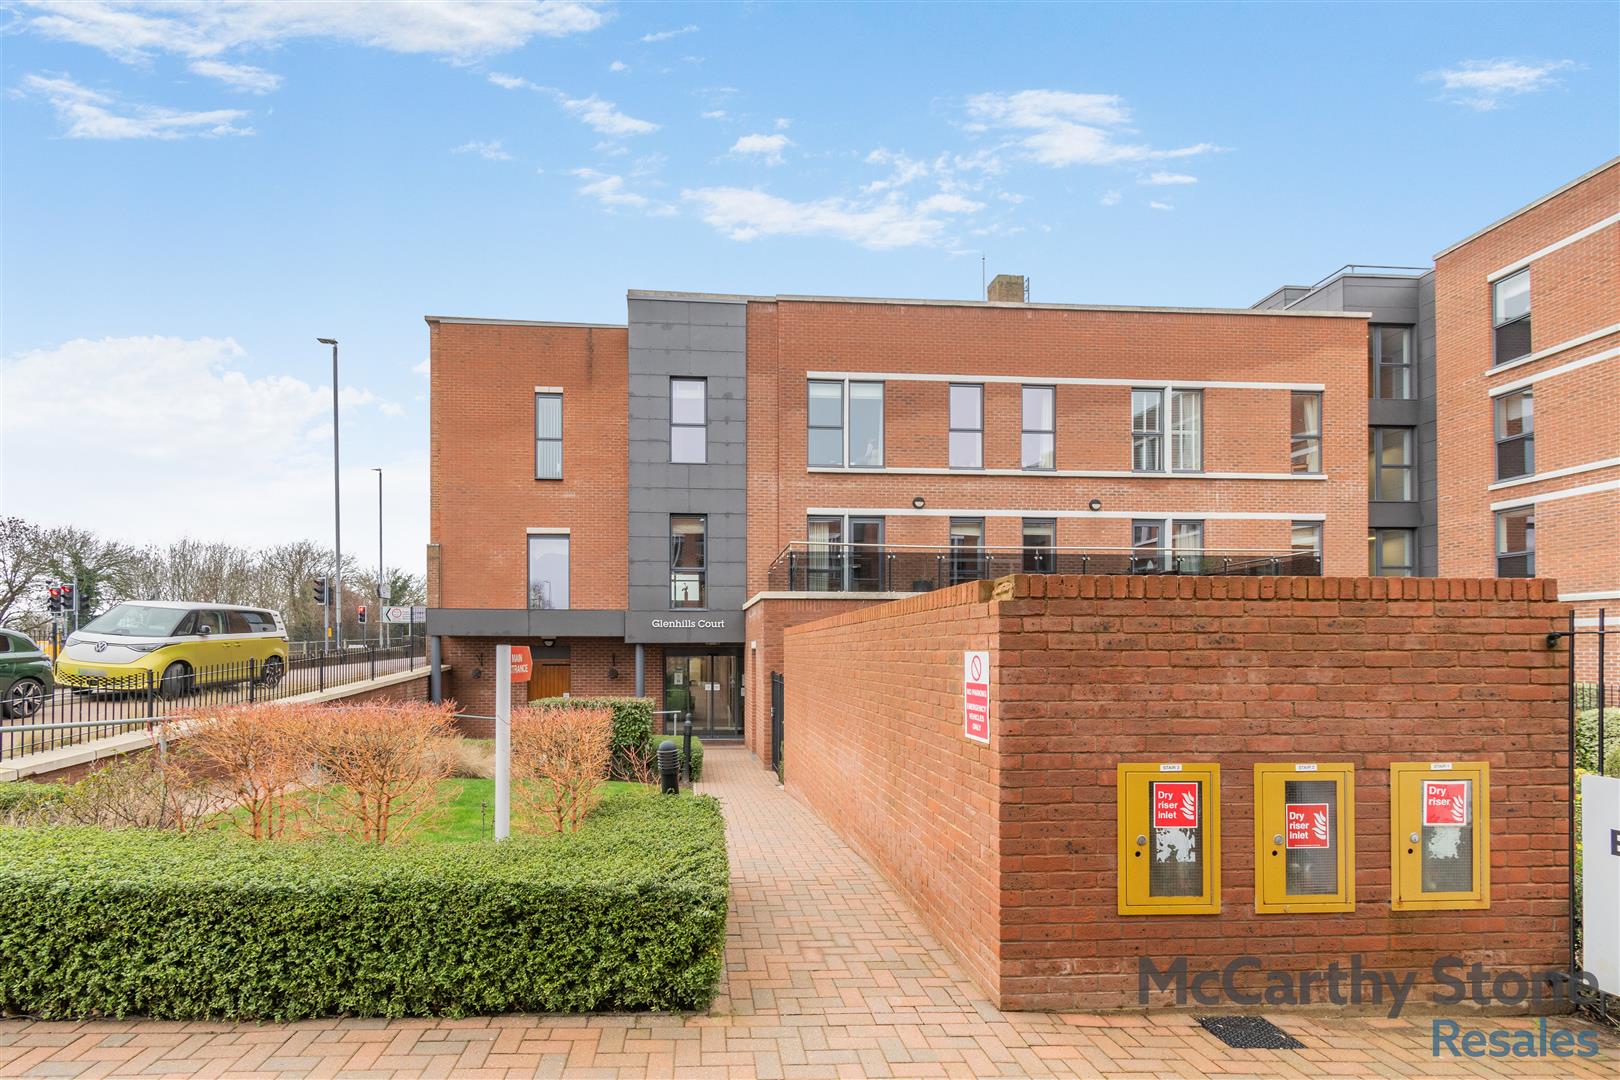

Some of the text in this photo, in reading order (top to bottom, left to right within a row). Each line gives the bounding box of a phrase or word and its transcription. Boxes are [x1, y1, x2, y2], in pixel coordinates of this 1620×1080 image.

[652, 620, 724, 628] Glenhills Court
[1158, 791, 1173, 800] Dry
[1429, 786, 1446, 796] Dry
[1158, 801, 1178, 809] riser
[1429, 797, 1450, 806] riser
[1158, 811, 1177, 819] inlet
[1290, 812, 1304, 822] Dry
[1290, 821, 1309, 830] riser
[1290, 831, 1308, 839] inlet
